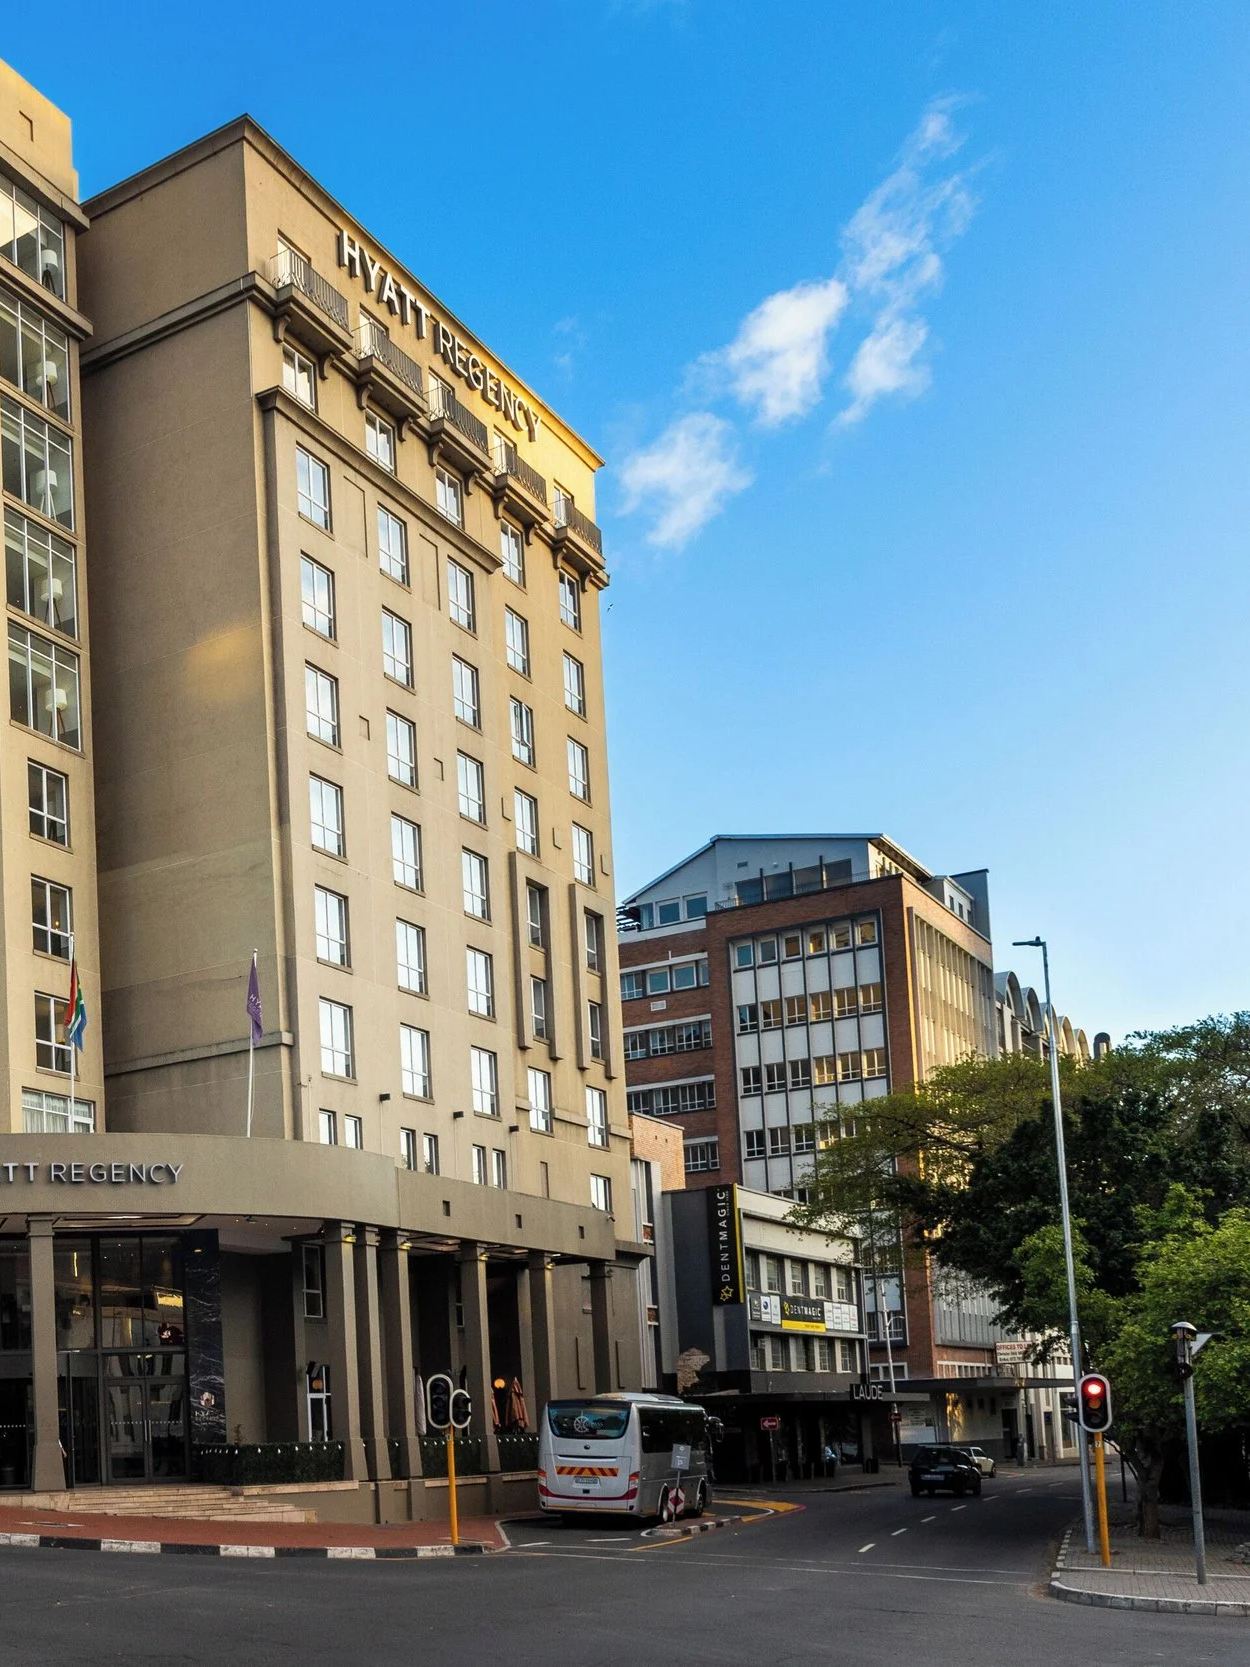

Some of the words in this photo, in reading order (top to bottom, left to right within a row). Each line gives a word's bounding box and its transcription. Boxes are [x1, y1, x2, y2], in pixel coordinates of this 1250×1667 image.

[339, 230, 431, 340] HYATT
[435, 321, 542, 443] REGENCY
[50, 1163, 184, 1184] REGENCY
[717, 1191, 731, 1282] DENTMAGIC
[790, 1304, 822, 1317] DENTMAGIC
[853, 1385, 883, 1400] LAUDE
